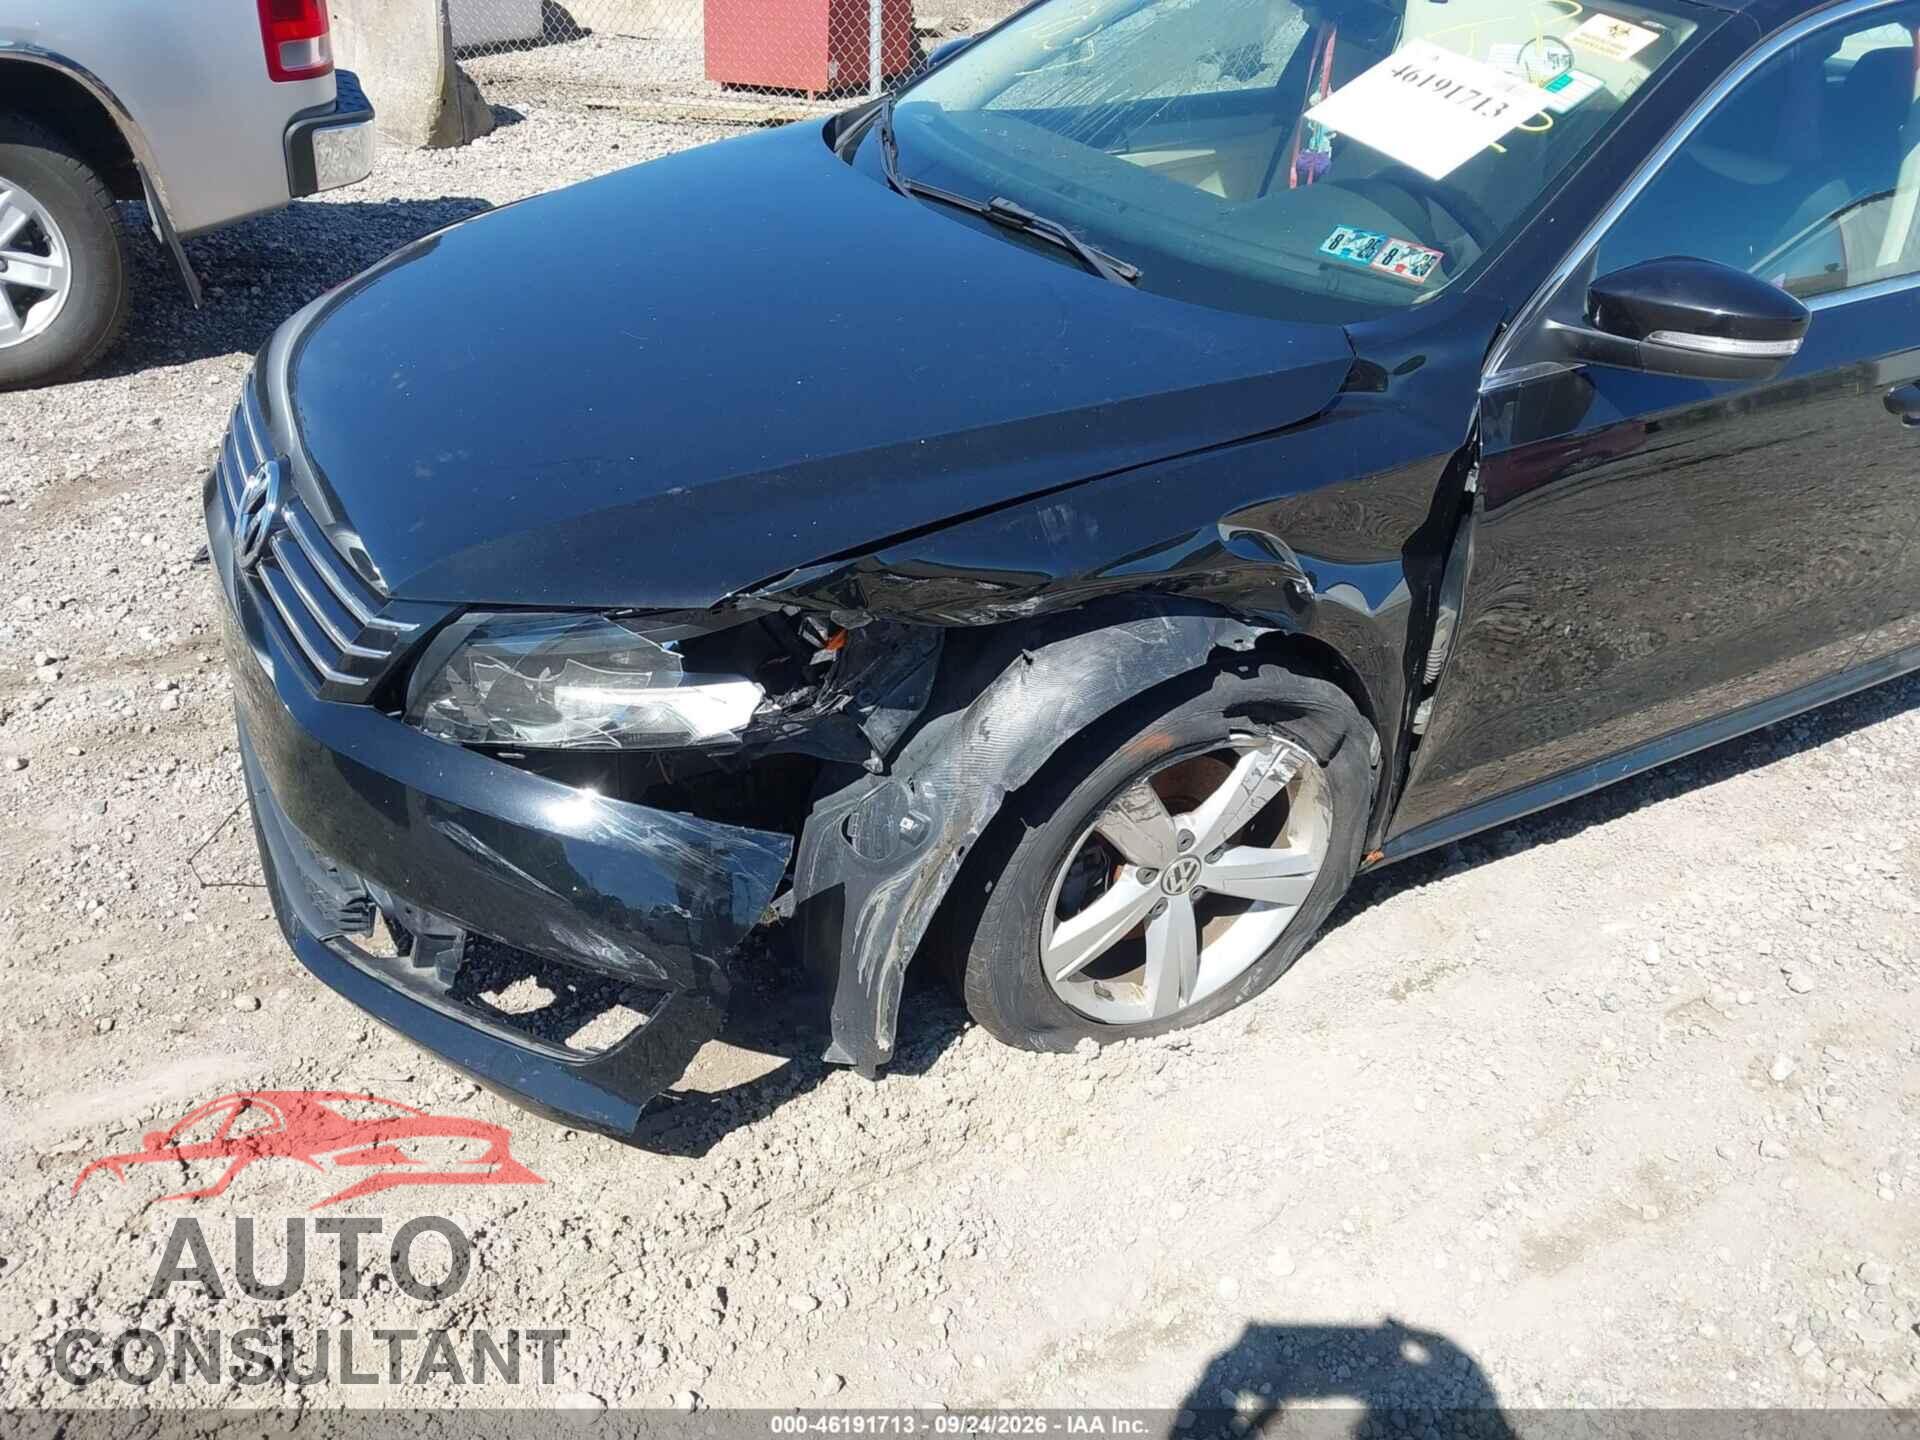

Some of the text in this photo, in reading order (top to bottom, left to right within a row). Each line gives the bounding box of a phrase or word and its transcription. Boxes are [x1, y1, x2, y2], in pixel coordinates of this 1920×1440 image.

[1391, 63, 1510, 118] 46191713
[1328, 233, 1345, 251] 8
[1382, 247, 1399, 266] 8
[1161, 856, 1201, 895] VW
